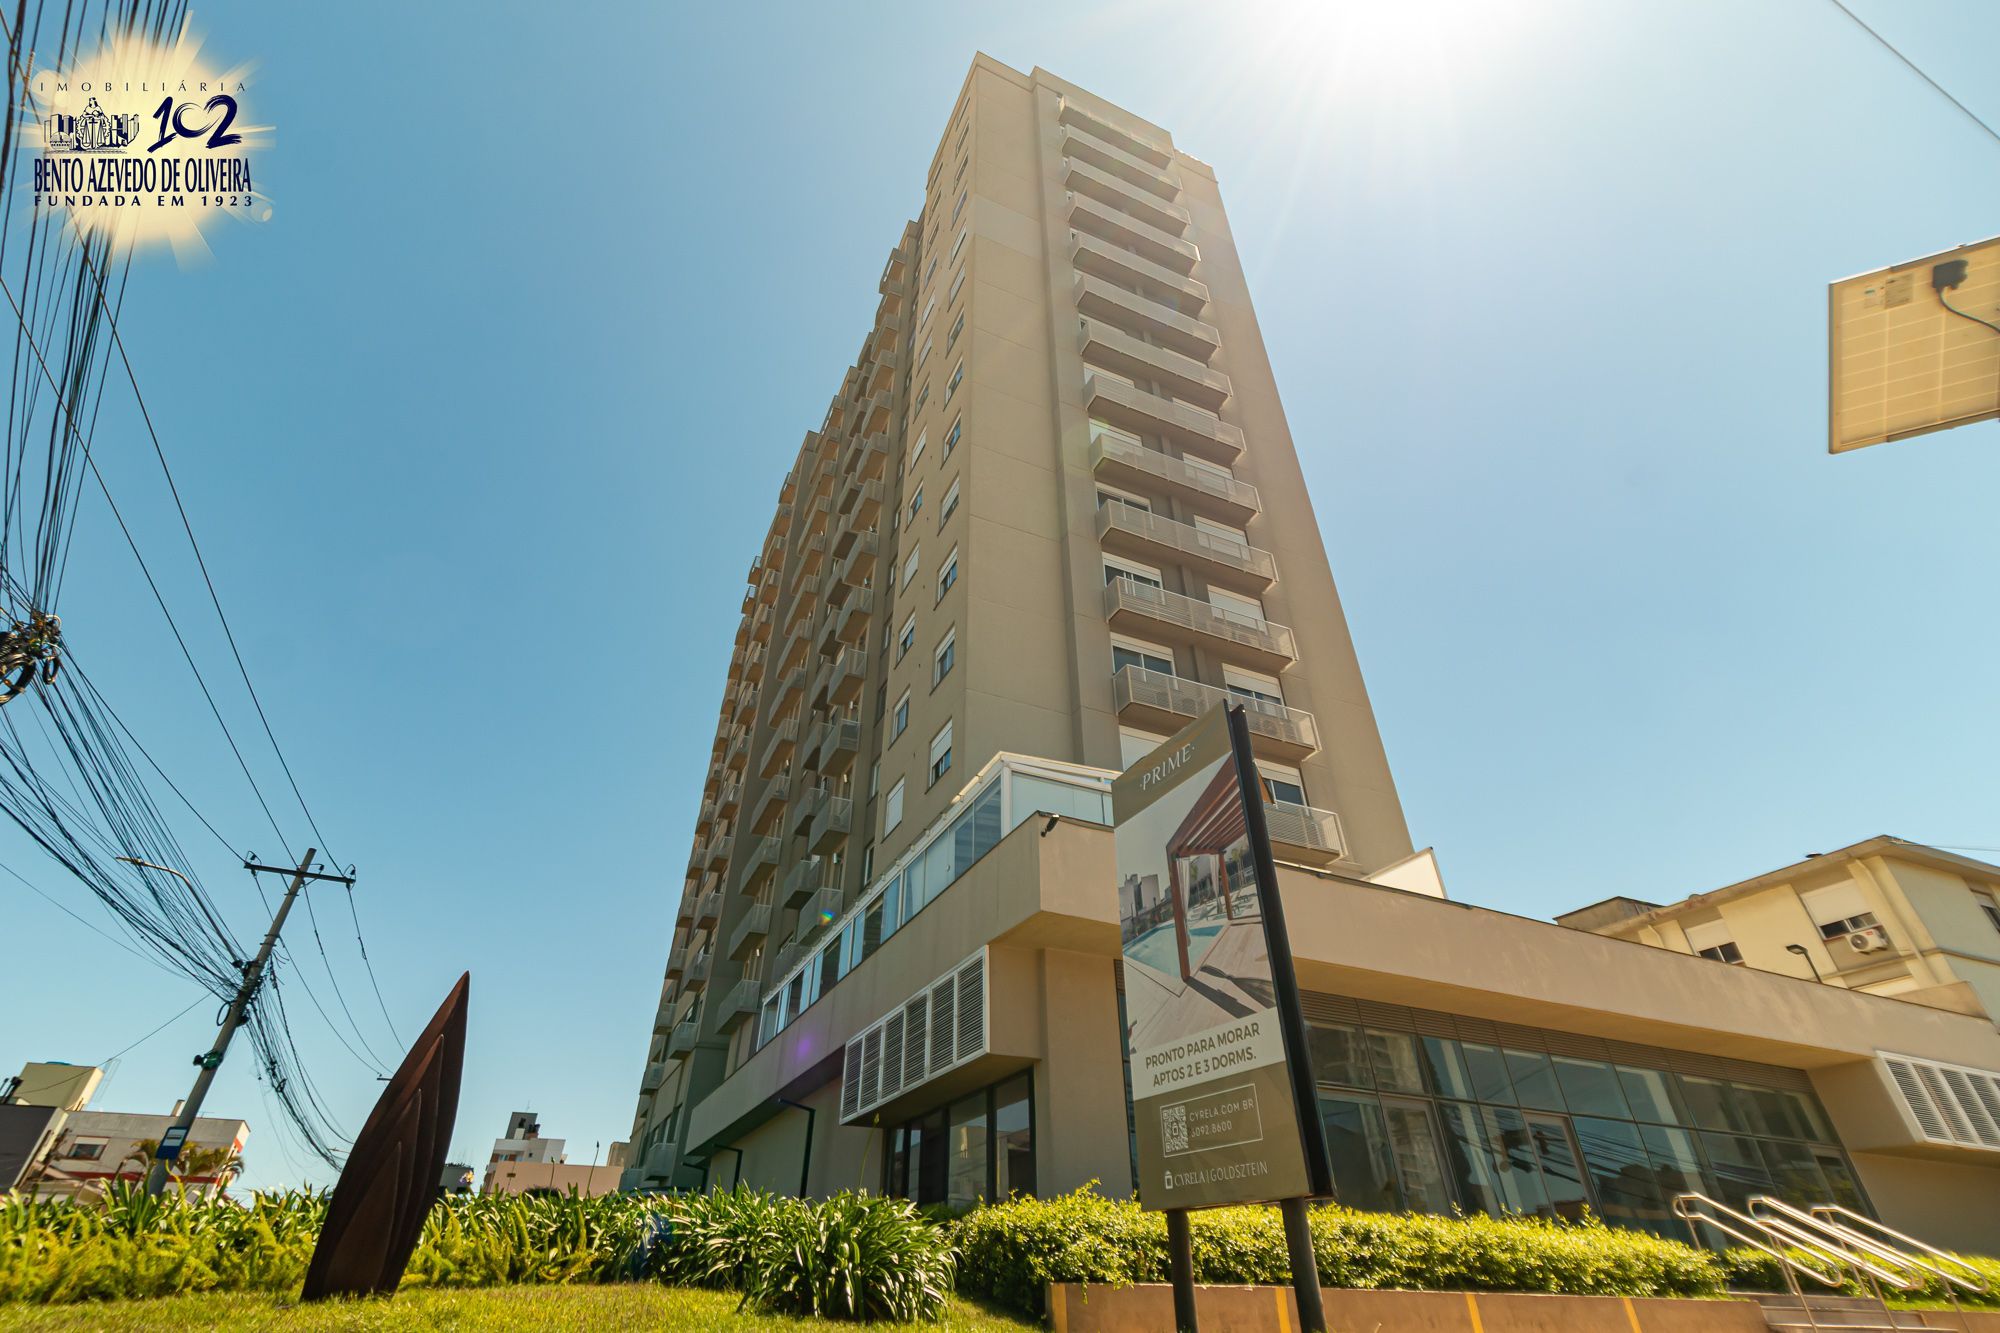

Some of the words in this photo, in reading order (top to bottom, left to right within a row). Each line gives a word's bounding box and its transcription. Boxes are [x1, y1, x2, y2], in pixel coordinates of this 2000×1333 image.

[1143, 743, 1192, 791] PRIME
[1145, 1046, 1185, 1070] PRONTO
[1187, 1036, 1216, 1056] PARA
[1217, 1022, 1260, 1047] MORAR
[1153, 1066, 1185, 1087] APTOS
[1187, 1064, 1194, 1078] 2
[1195, 1061, 1202, 1076] E
[1204, 1059, 1210, 1073] 3
[1212, 1046, 1257, 1070] DORMS.
